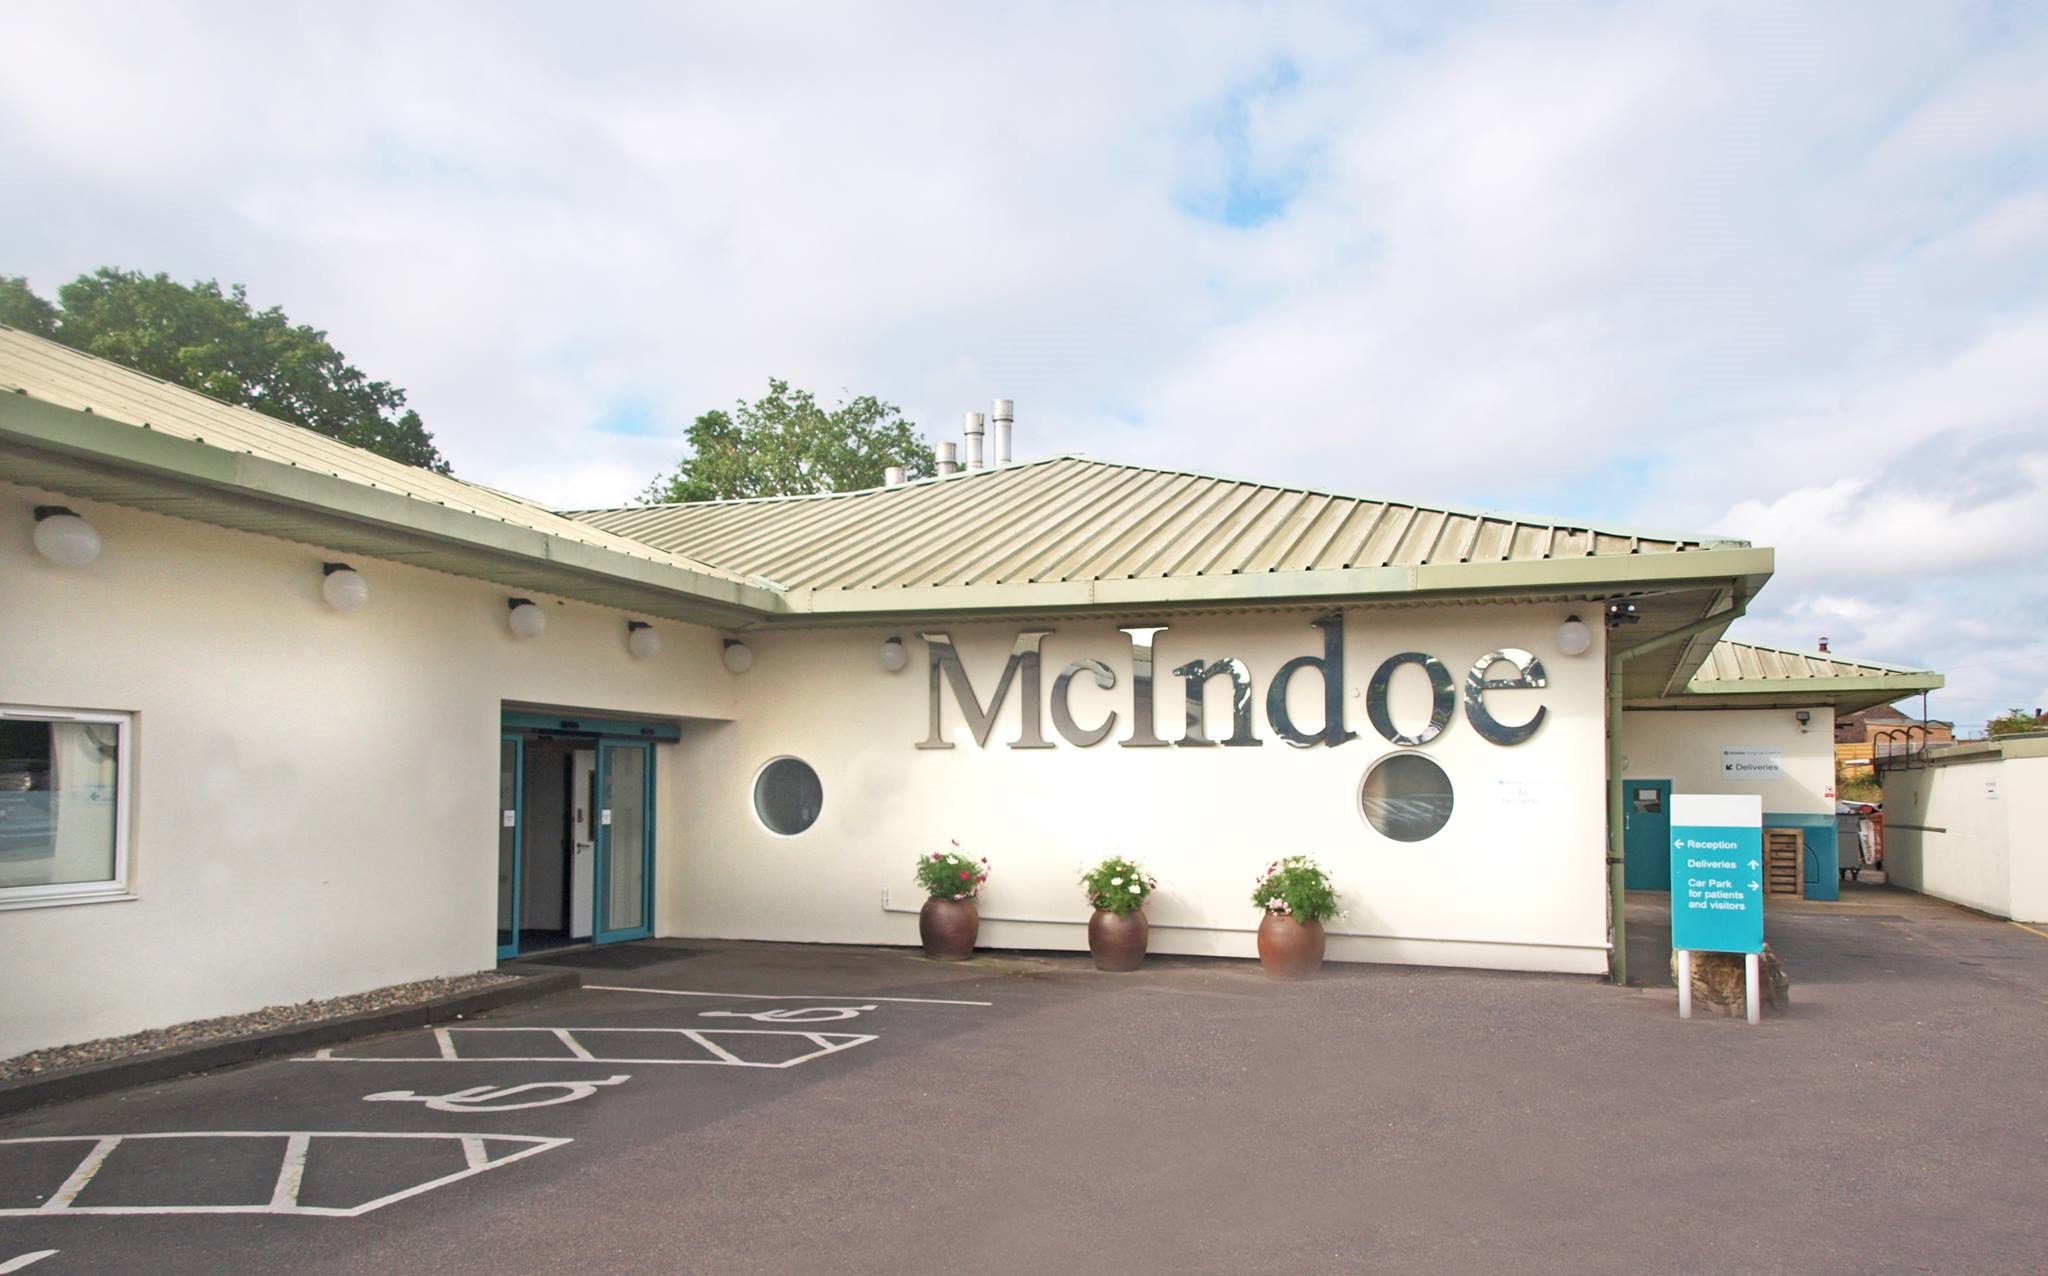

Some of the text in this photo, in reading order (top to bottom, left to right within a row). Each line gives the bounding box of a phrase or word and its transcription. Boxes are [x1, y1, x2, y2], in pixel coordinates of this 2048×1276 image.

[915, 613, 1548, 749] McIndoe
[1736, 763, 1779, 771] Deliveries
[1687, 840, 1737, 850] Reception
[1687, 859, 1737, 869] Deliveries
[1688, 879, 1732, 888] Car Park
[1688, 889, 1744, 900] for patients
[1688, 901, 1746, 911] and visitors
